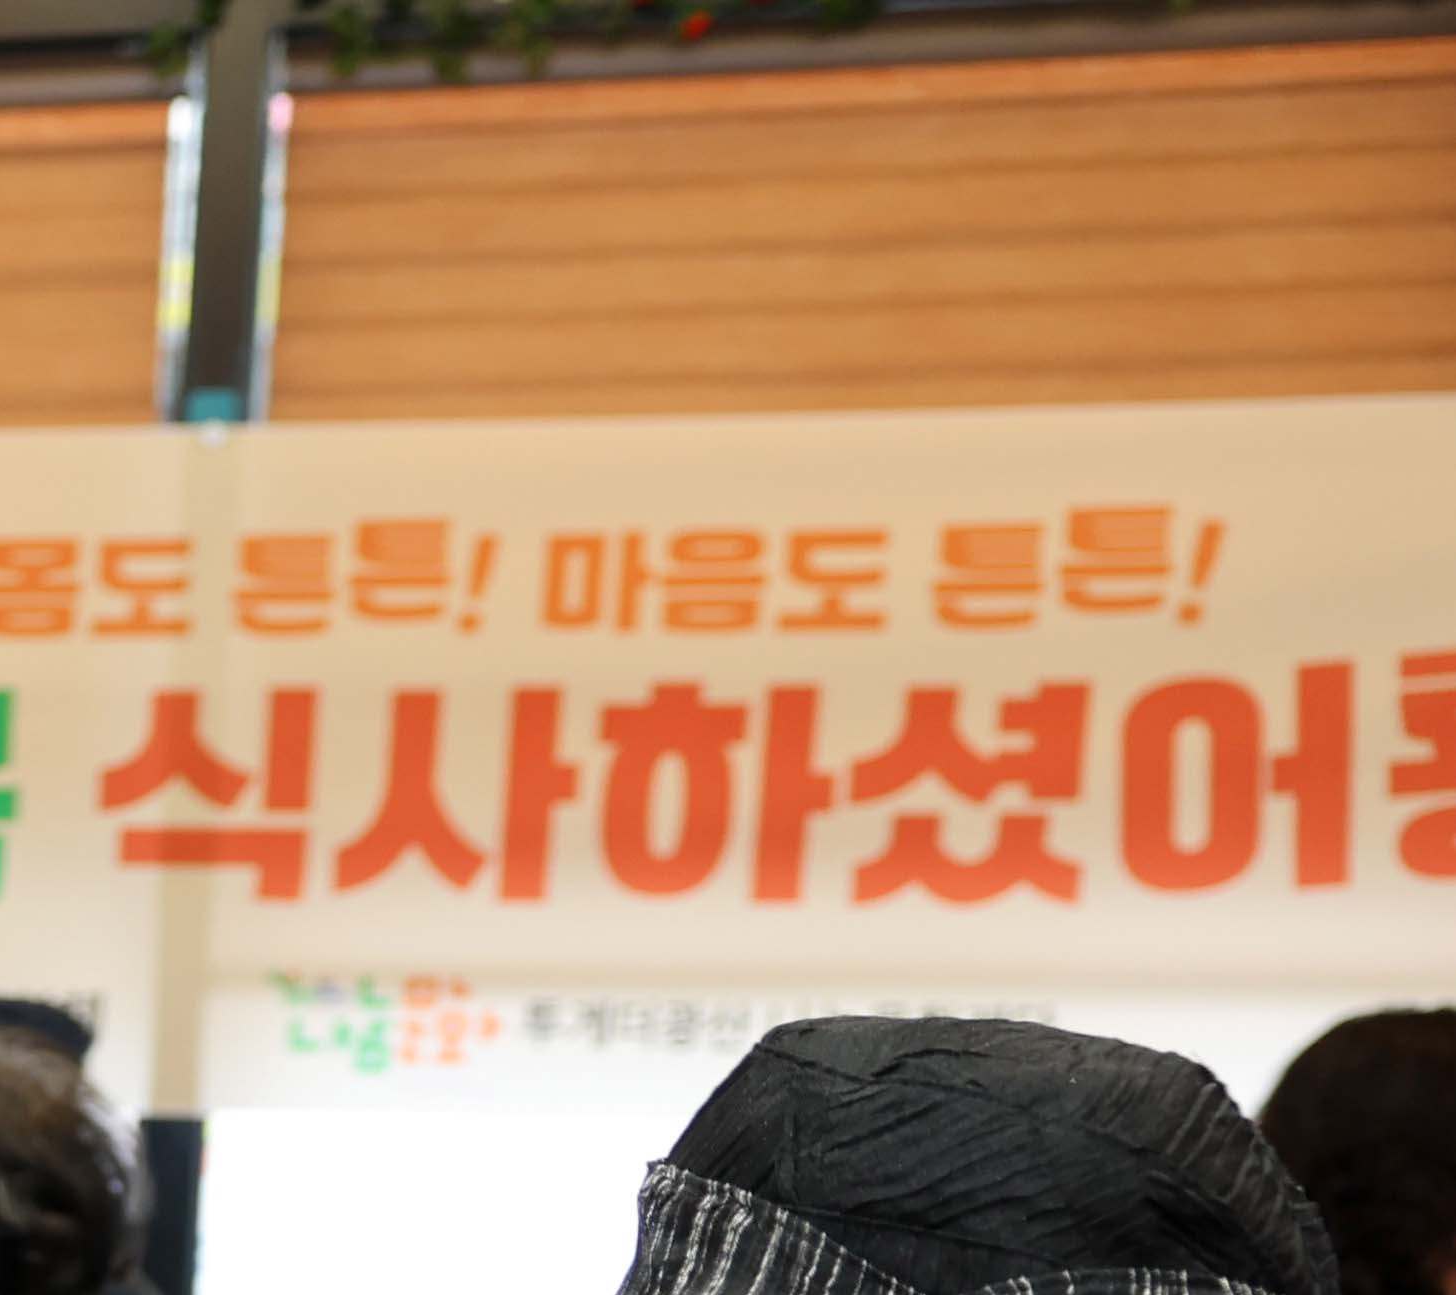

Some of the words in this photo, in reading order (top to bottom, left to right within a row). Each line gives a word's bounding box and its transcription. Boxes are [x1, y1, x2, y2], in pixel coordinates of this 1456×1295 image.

[231, 517, 501, 637] 튼튼!
[537, 526, 890, 634] 마음도
[930, 505, 1226, 630] 튼튼!
